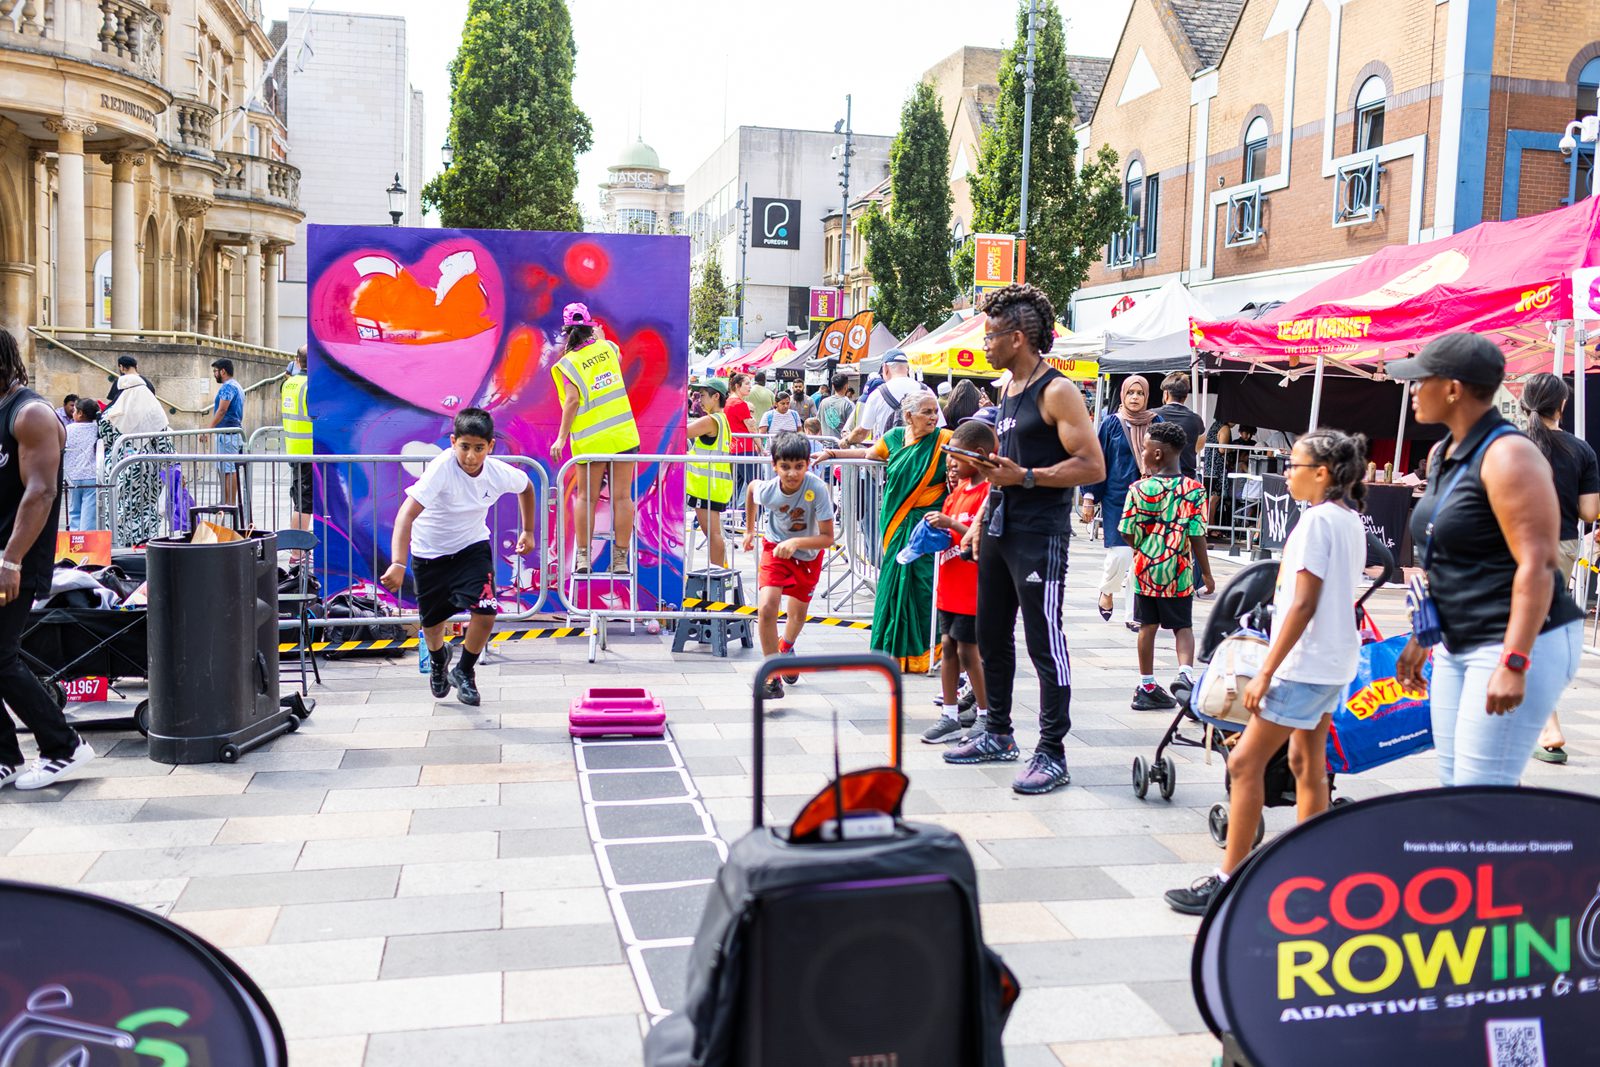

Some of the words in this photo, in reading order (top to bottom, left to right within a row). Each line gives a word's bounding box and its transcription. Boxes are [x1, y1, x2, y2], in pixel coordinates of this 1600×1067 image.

[1315, 315, 1372, 339] MARKET
[582, 351, 611, 370] ARTIST
[1403, 840, 1428, 852] from
[1428, 841, 1444, 852] the
[1445, 841, 1468, 853] UK's
[1469, 840, 1486, 852] 1st
[1487, 841, 1528, 852] Gladiator
[1529, 840, 1573, 854] Champion
[1268, 864, 1523, 936] COOL
[1279, 997, 1439, 1023] ADAPTIVE
[1445, 983, 1547, 1009] SPORT
